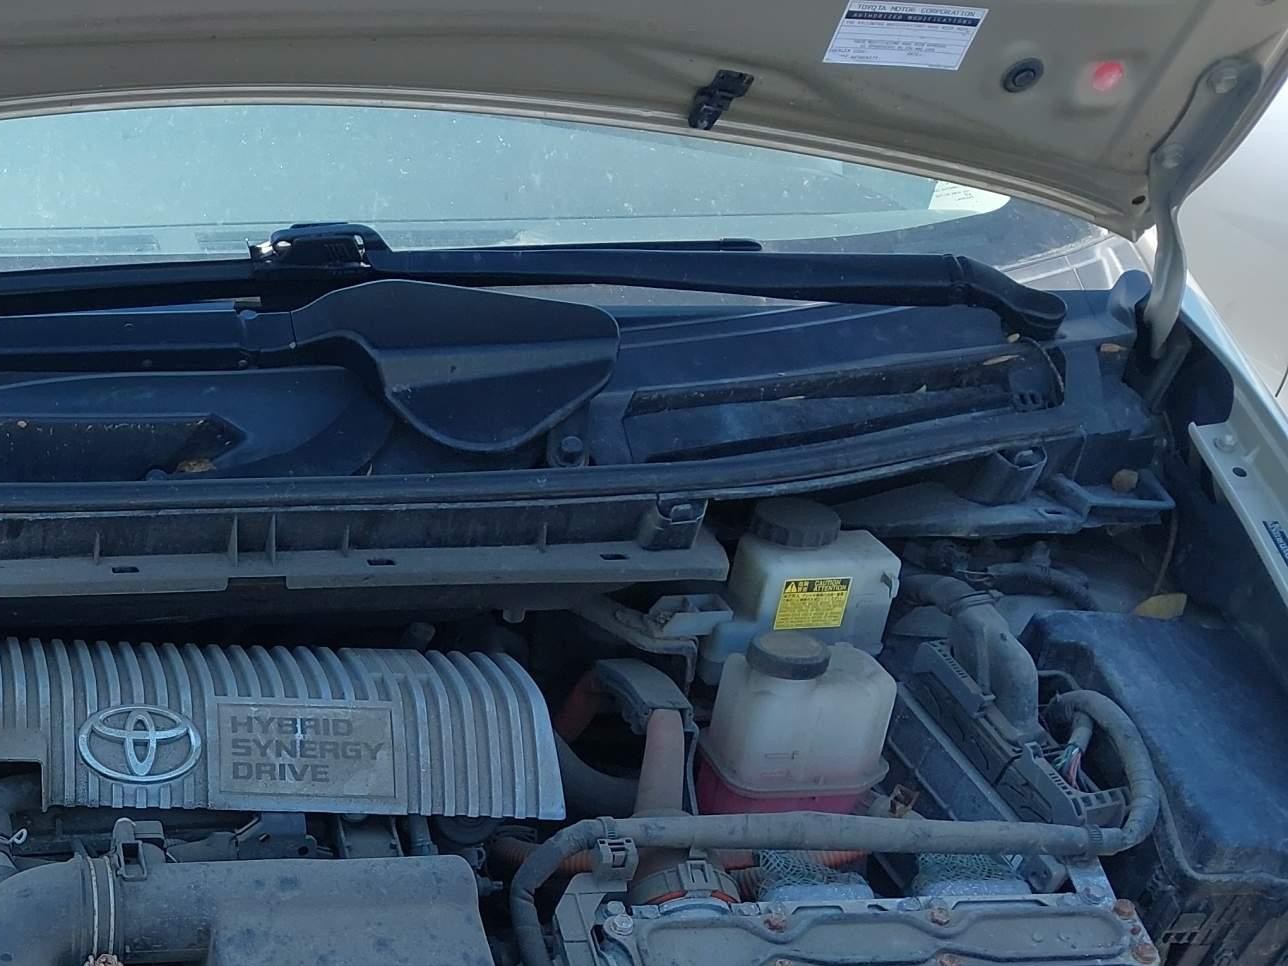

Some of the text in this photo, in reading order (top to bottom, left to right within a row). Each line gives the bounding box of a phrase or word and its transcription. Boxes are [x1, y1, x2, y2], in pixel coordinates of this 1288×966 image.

[857, 3, 976, 17] TOYOTA MOTOR CORPORATION
[230, 715, 353, 737] HYBRID
[230, 738, 385, 761] SYNERGY
[231, 761, 330, 783] DRIVE
